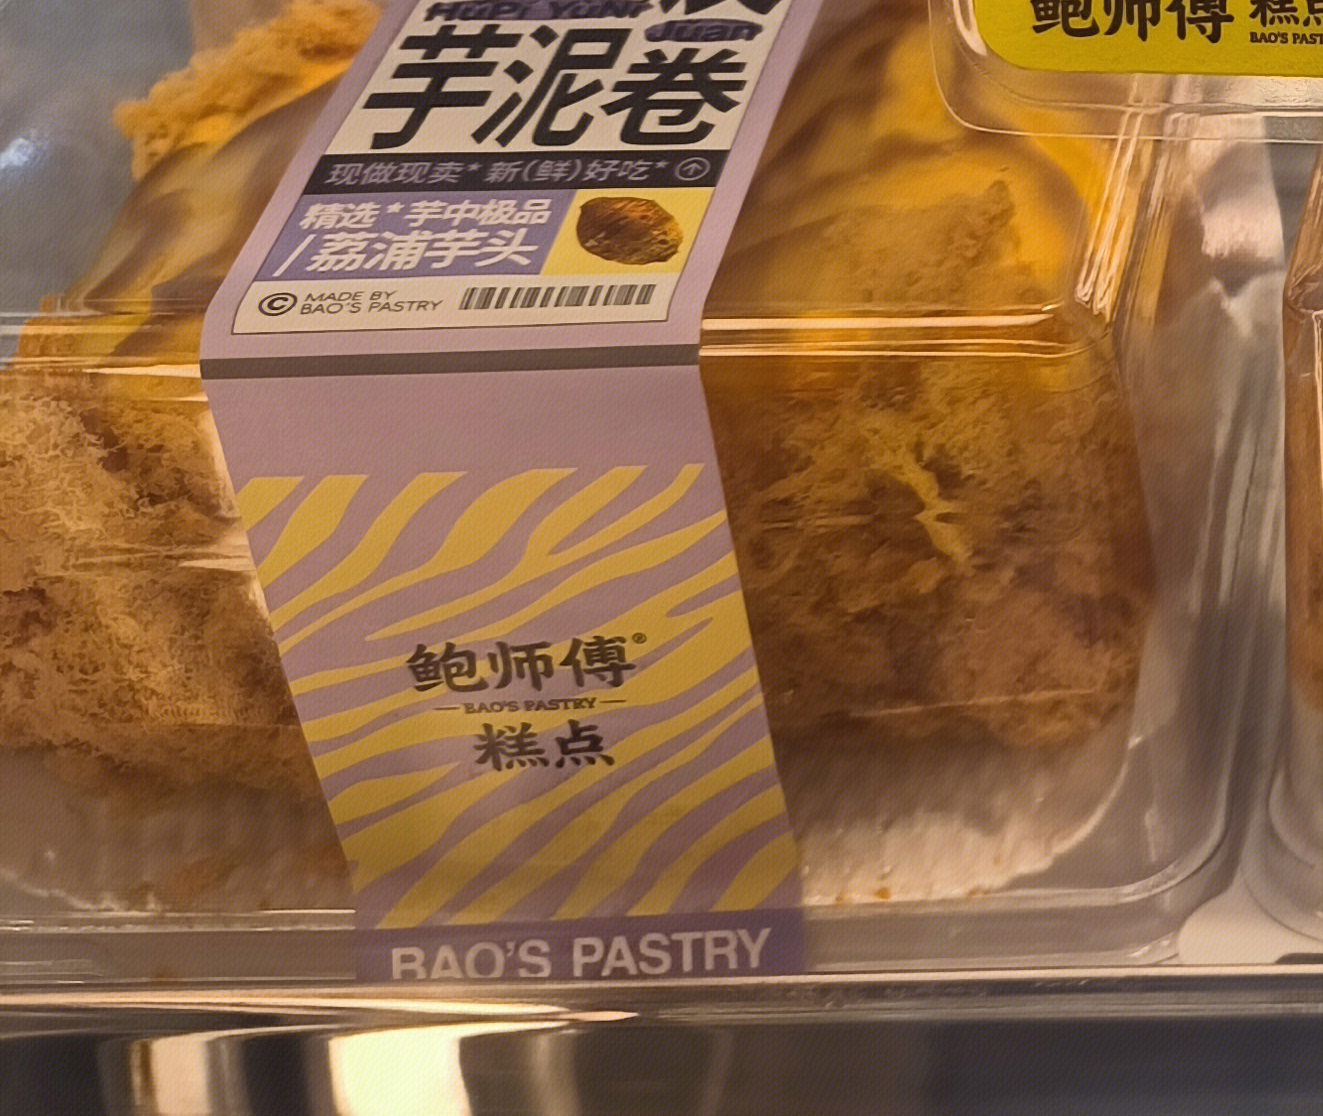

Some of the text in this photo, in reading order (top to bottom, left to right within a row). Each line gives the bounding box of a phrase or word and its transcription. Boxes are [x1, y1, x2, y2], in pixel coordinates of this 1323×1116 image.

[1249, 31, 1289, 44] BAO'S
[363, 23, 748, 150] 芋泥卷
[300, 299, 444, 316] BAO'S PASTRY
[303, 289, 398, 303] MADE BY
[406, 635, 637, 693] 鲍师傅
[463, 696, 598, 715] BAO'S PASTRY
[473, 719, 616, 772] 糕点
[391, 927, 772, 980] BAO'S PASTRY
